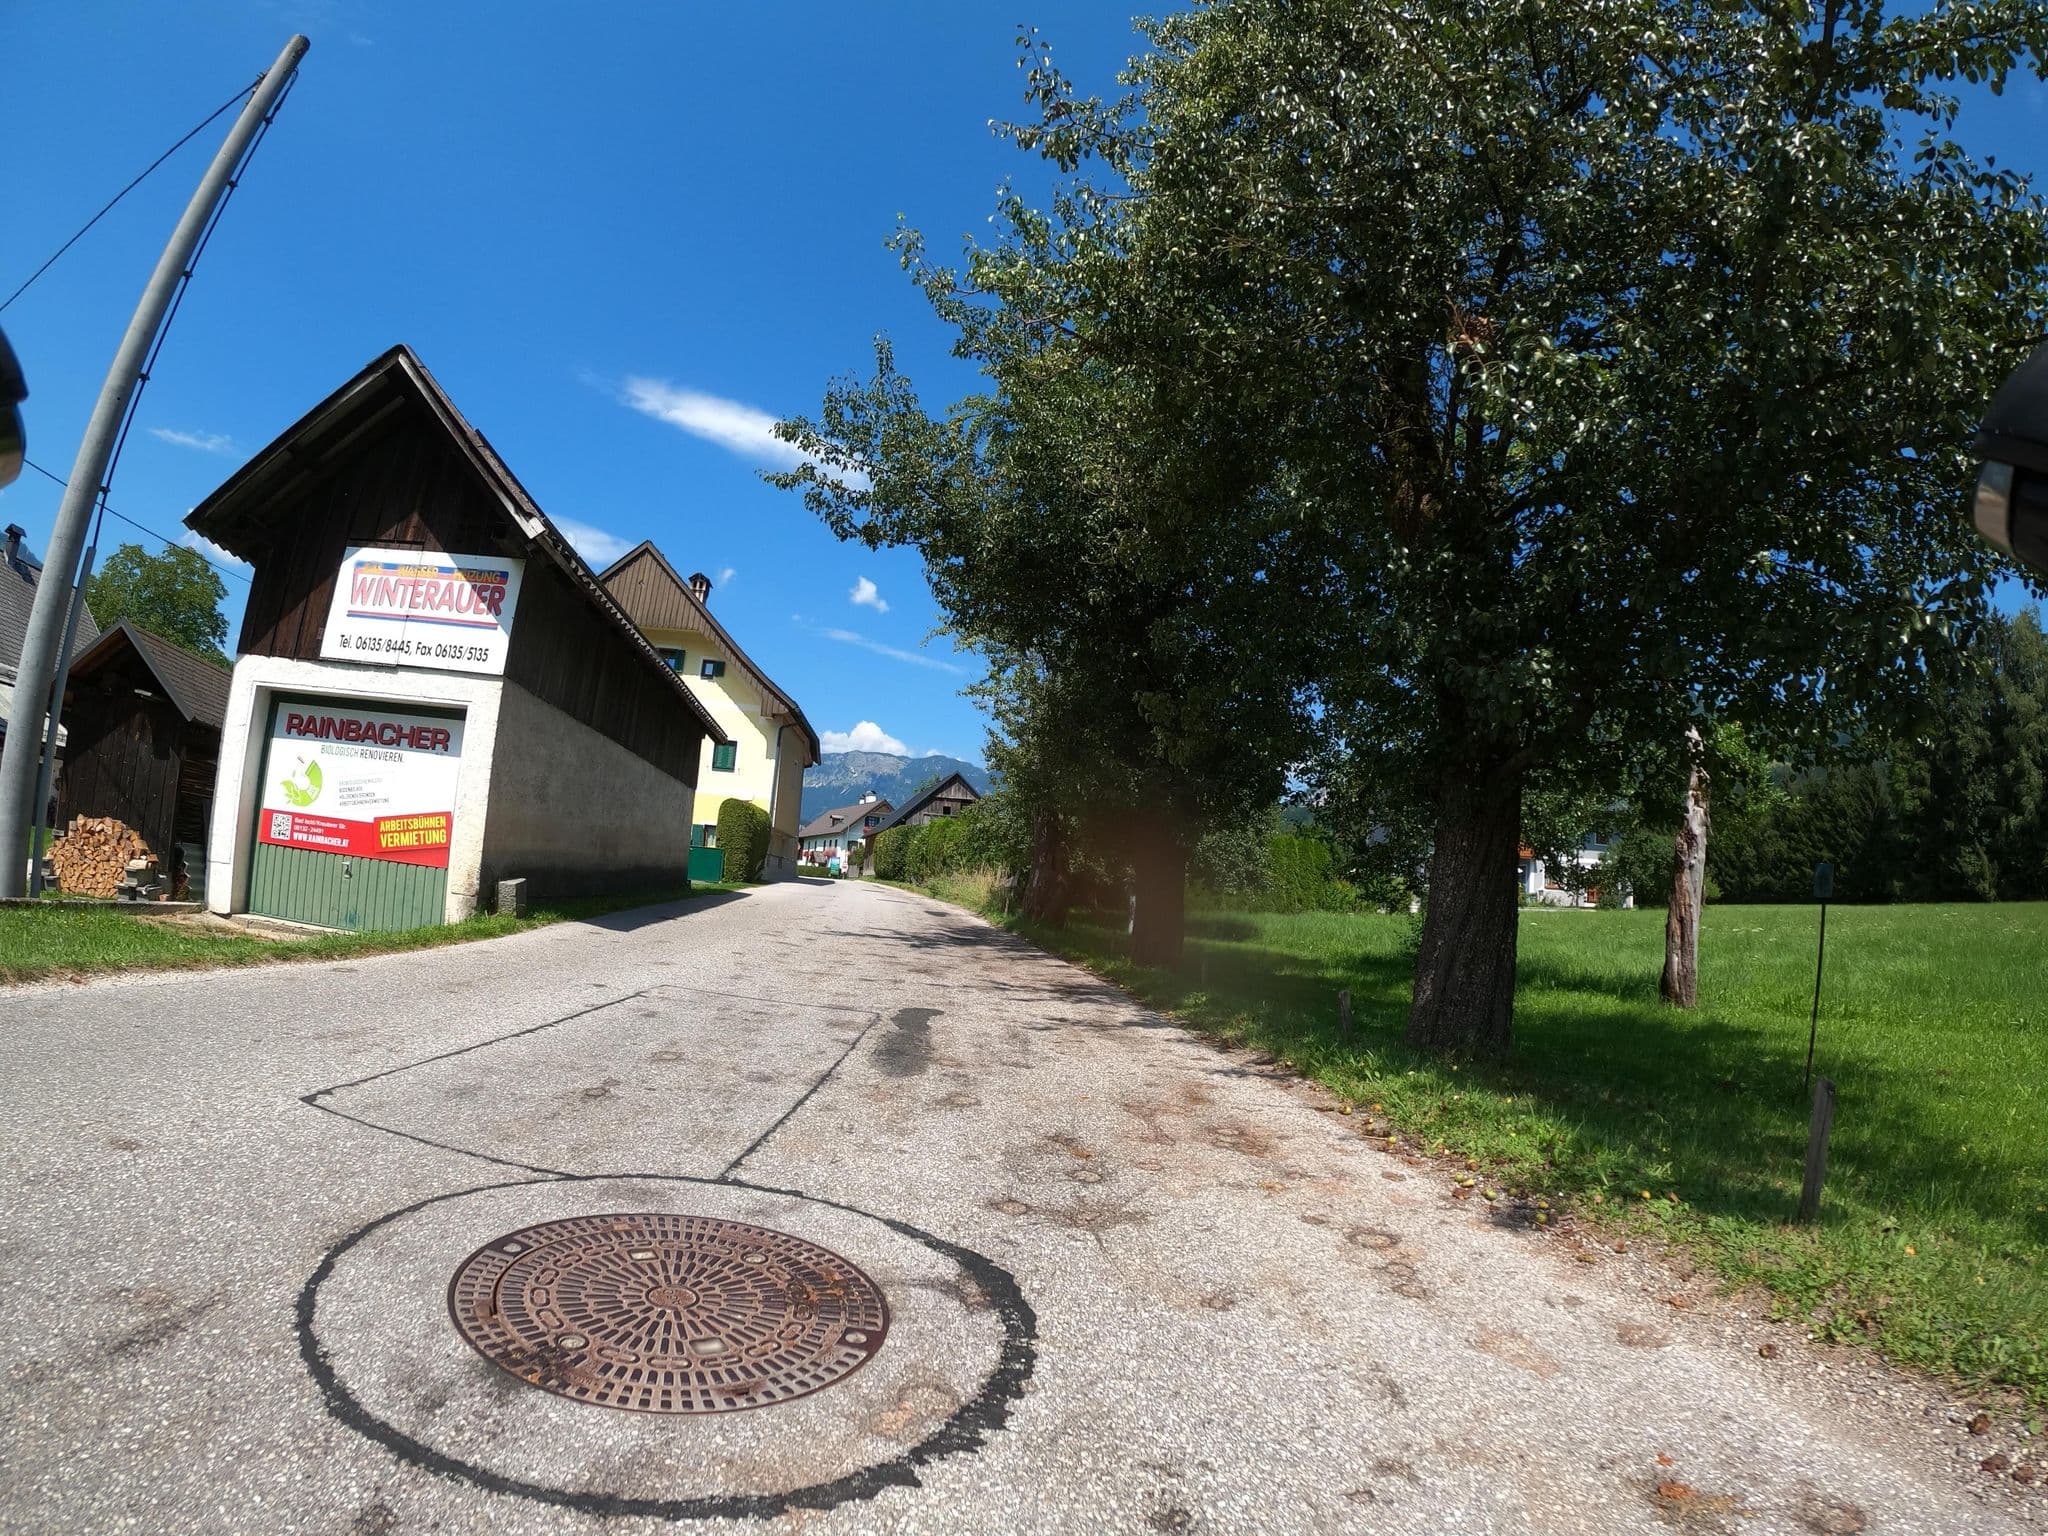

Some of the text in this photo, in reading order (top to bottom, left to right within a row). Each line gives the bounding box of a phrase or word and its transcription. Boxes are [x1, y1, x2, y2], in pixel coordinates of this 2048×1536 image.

[351, 576, 506, 616] WINTERAUER
[339, 635, 489, 662] Tel. 06135/8445, Fax 06135/5135
[285, 713, 451, 752] RAINBACHER
[320, 744, 359, 758] BIOLOGISCH
[380, 815, 446, 832] ARBEITSBÜHNEN
[380, 831, 447, 848] VERMIETUNG
